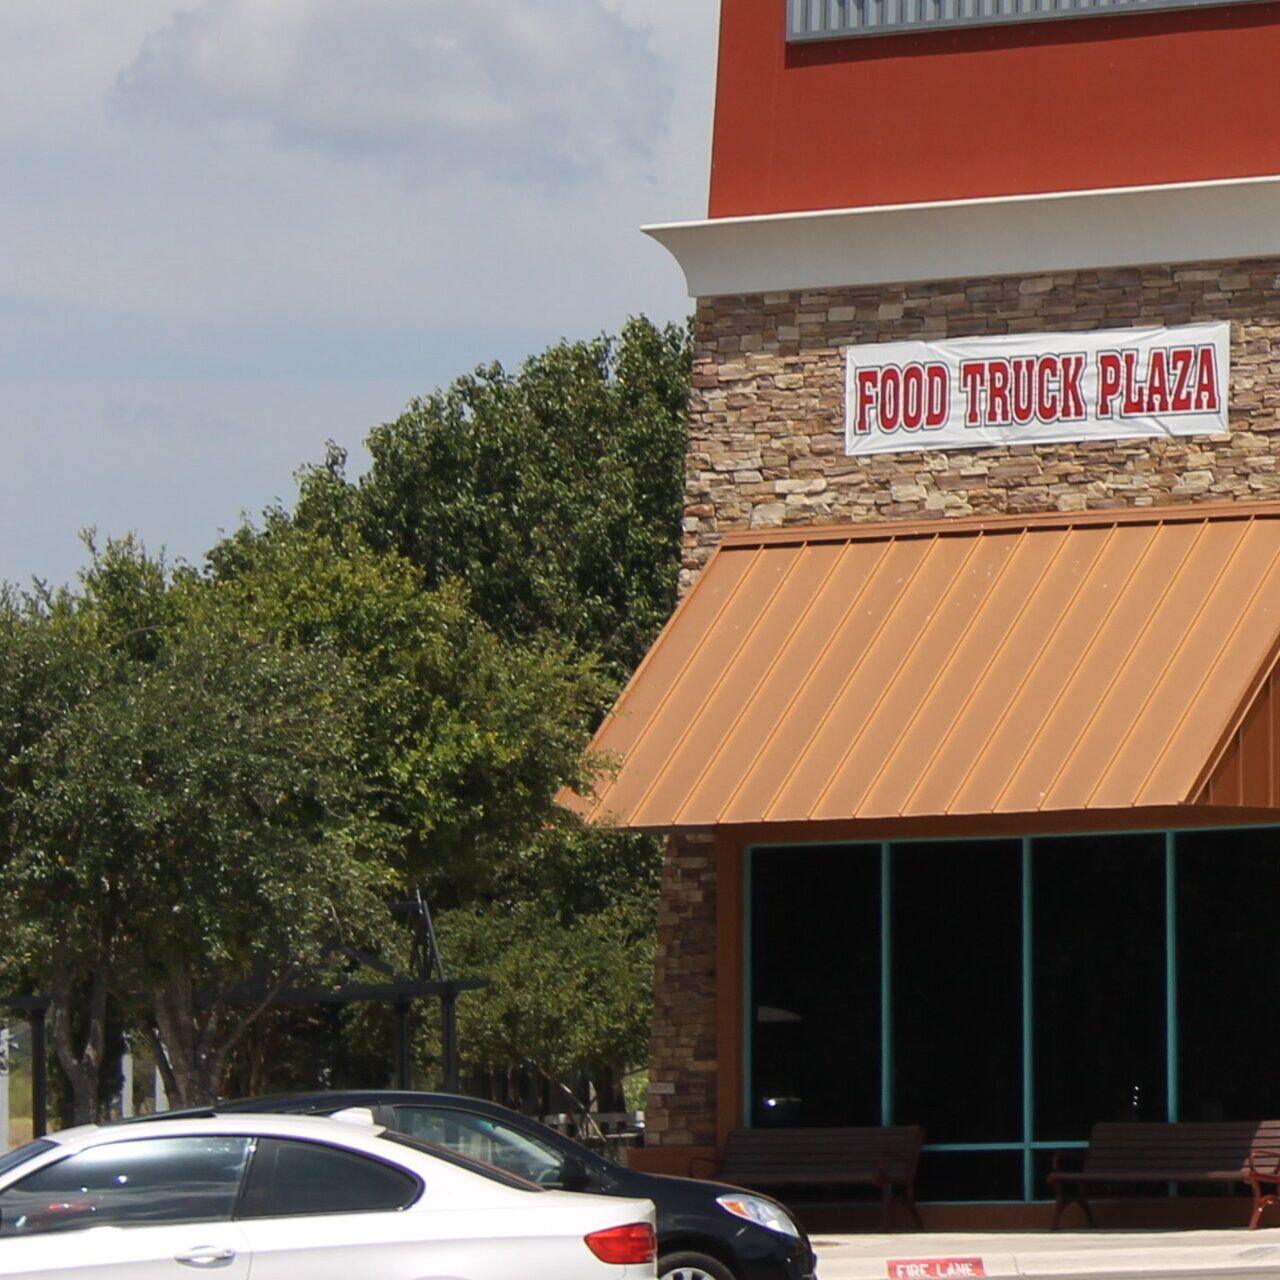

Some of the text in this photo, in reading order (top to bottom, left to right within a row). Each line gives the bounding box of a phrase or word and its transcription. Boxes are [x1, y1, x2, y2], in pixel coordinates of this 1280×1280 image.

[854, 343, 1220, 435] FOOD TRUCK PLAZA
[896, 1262, 976, 1279] FIRE LANE
